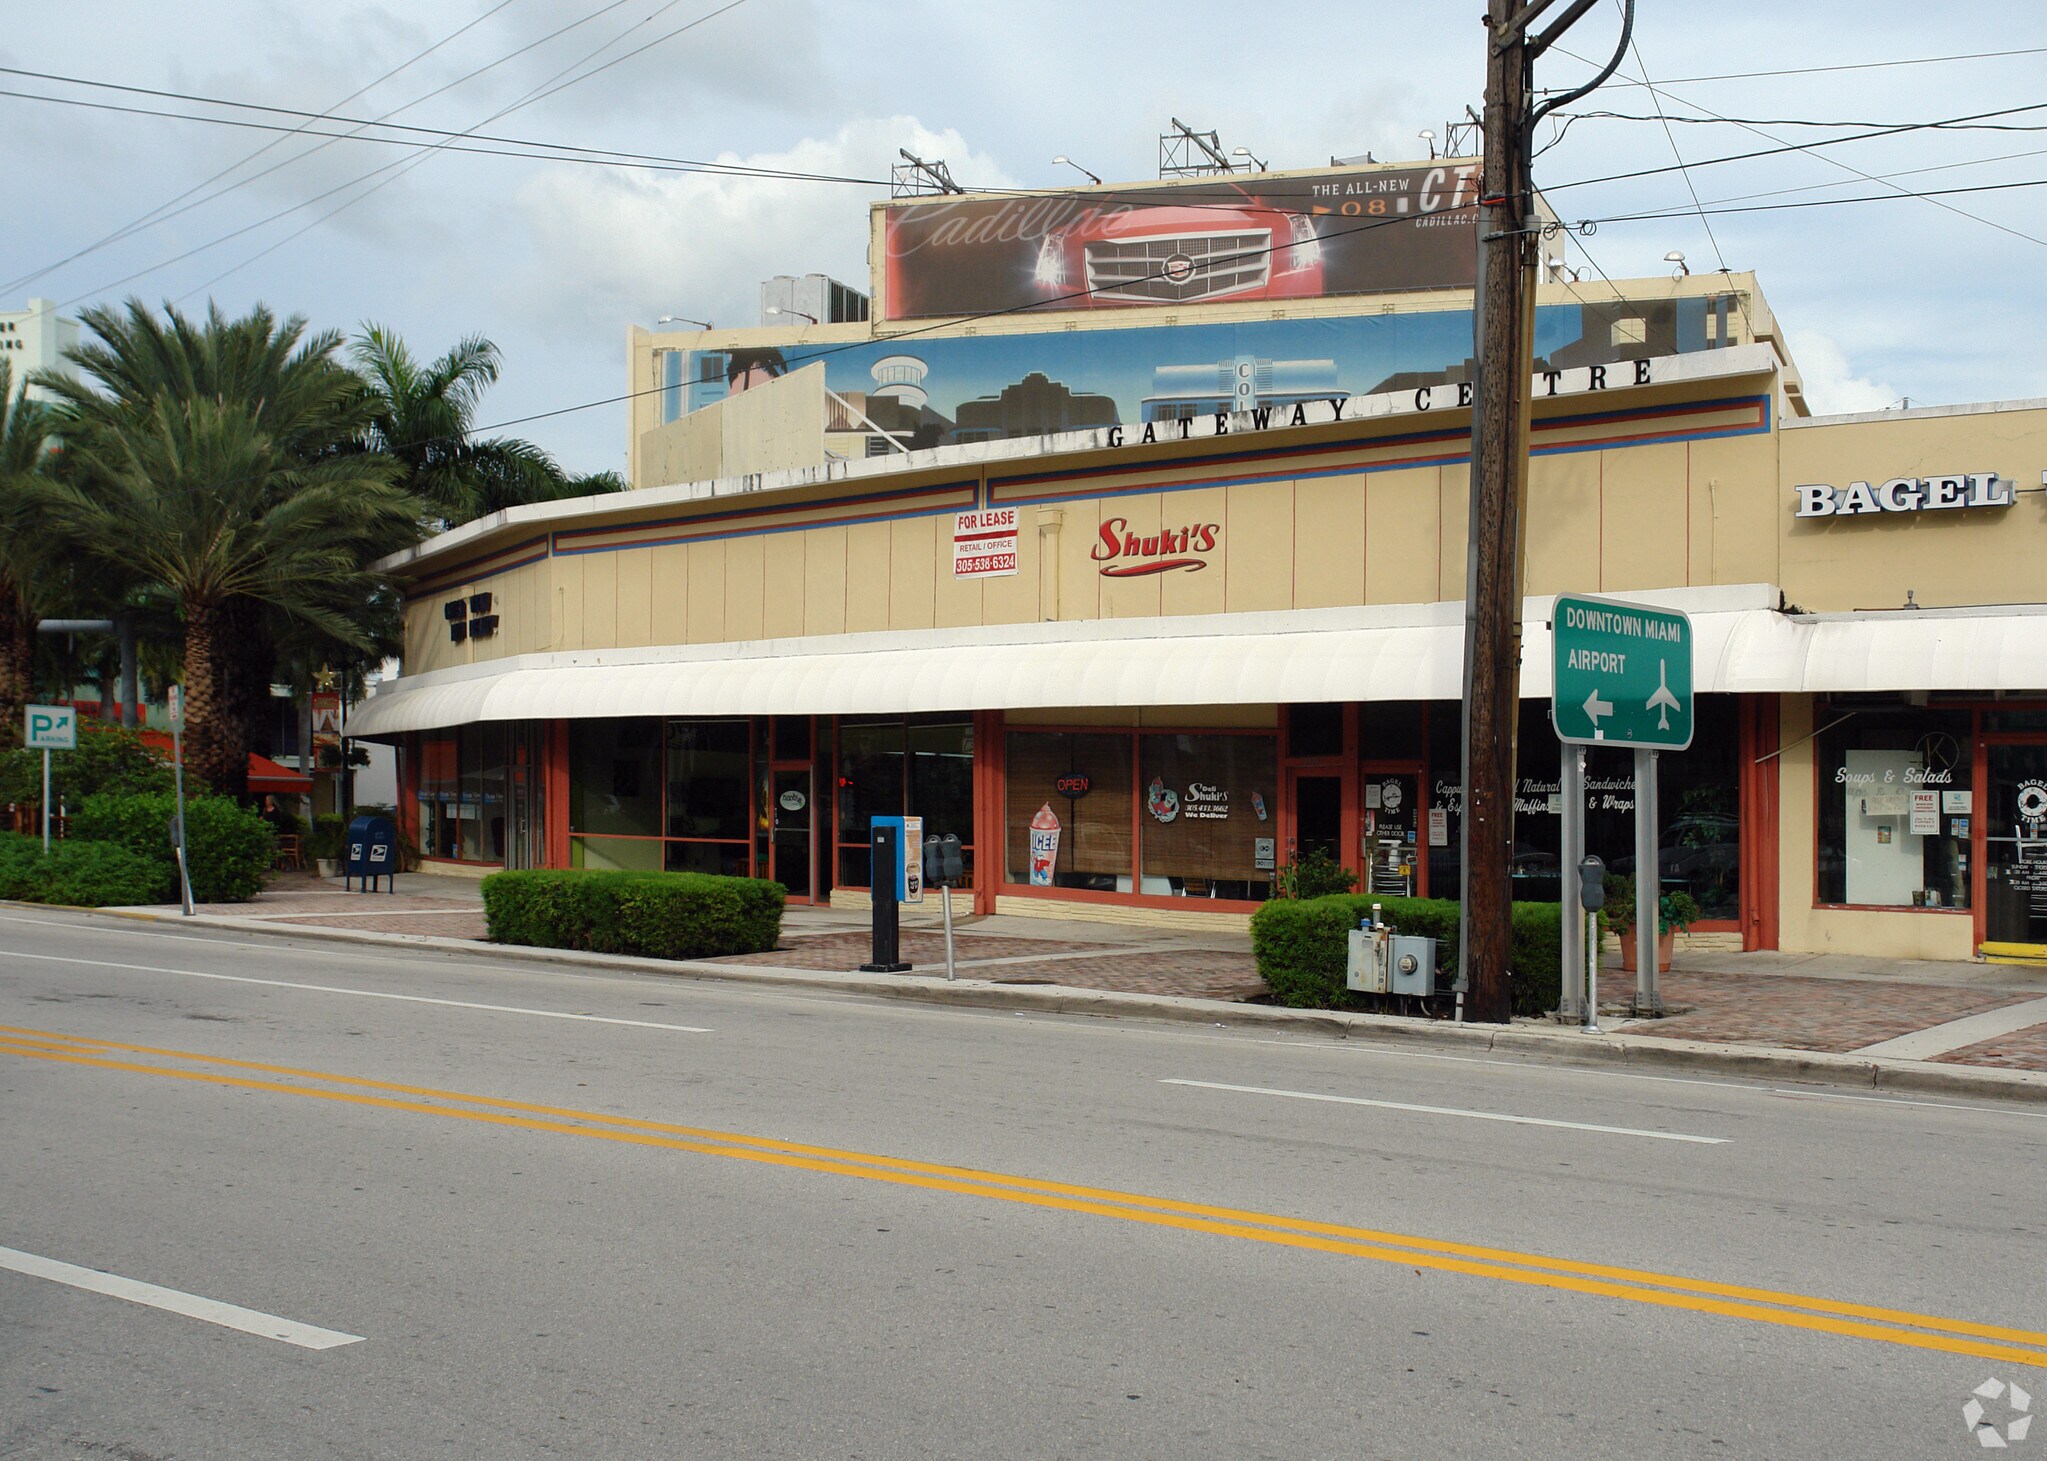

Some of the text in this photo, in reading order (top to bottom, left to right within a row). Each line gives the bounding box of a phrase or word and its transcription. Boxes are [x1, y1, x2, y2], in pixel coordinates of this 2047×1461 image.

[1312, 178, 1410, 197] THE ALL-NEW
[1419, 164, 1478, 213] CT
[1340, 199, 1387, 216] 08
[886, 194, 1134, 258] Cadillac
[1108, 359, 1651, 448] GATEWAY CETRE
[1795, 471, 2009, 518] BAGEL
[958, 510, 1014, 530] FOR LEASE
[960, 543, 982, 552] RETAIL
[987, 539, 1013, 550] OFFICE
[1566, 606, 1681, 643] DOWNTOWN MIAMI
[1567, 648, 1626, 674] AIRPORT
[1057, 778, 1089, 791] OPEN
[1523, 778, 1562, 794] Natural
[1584, 775, 1636, 790] Sandwiche
[1835, 766, 1953, 788] Soups & Salads
[1384, 807, 1401, 815] TIME
[1588, 796, 1598, 809] &
[1602, 795, 1636, 814] Wraps
[2021, 814, 2047, 824] TIME
[1031, 833, 1057, 851] ICEE
